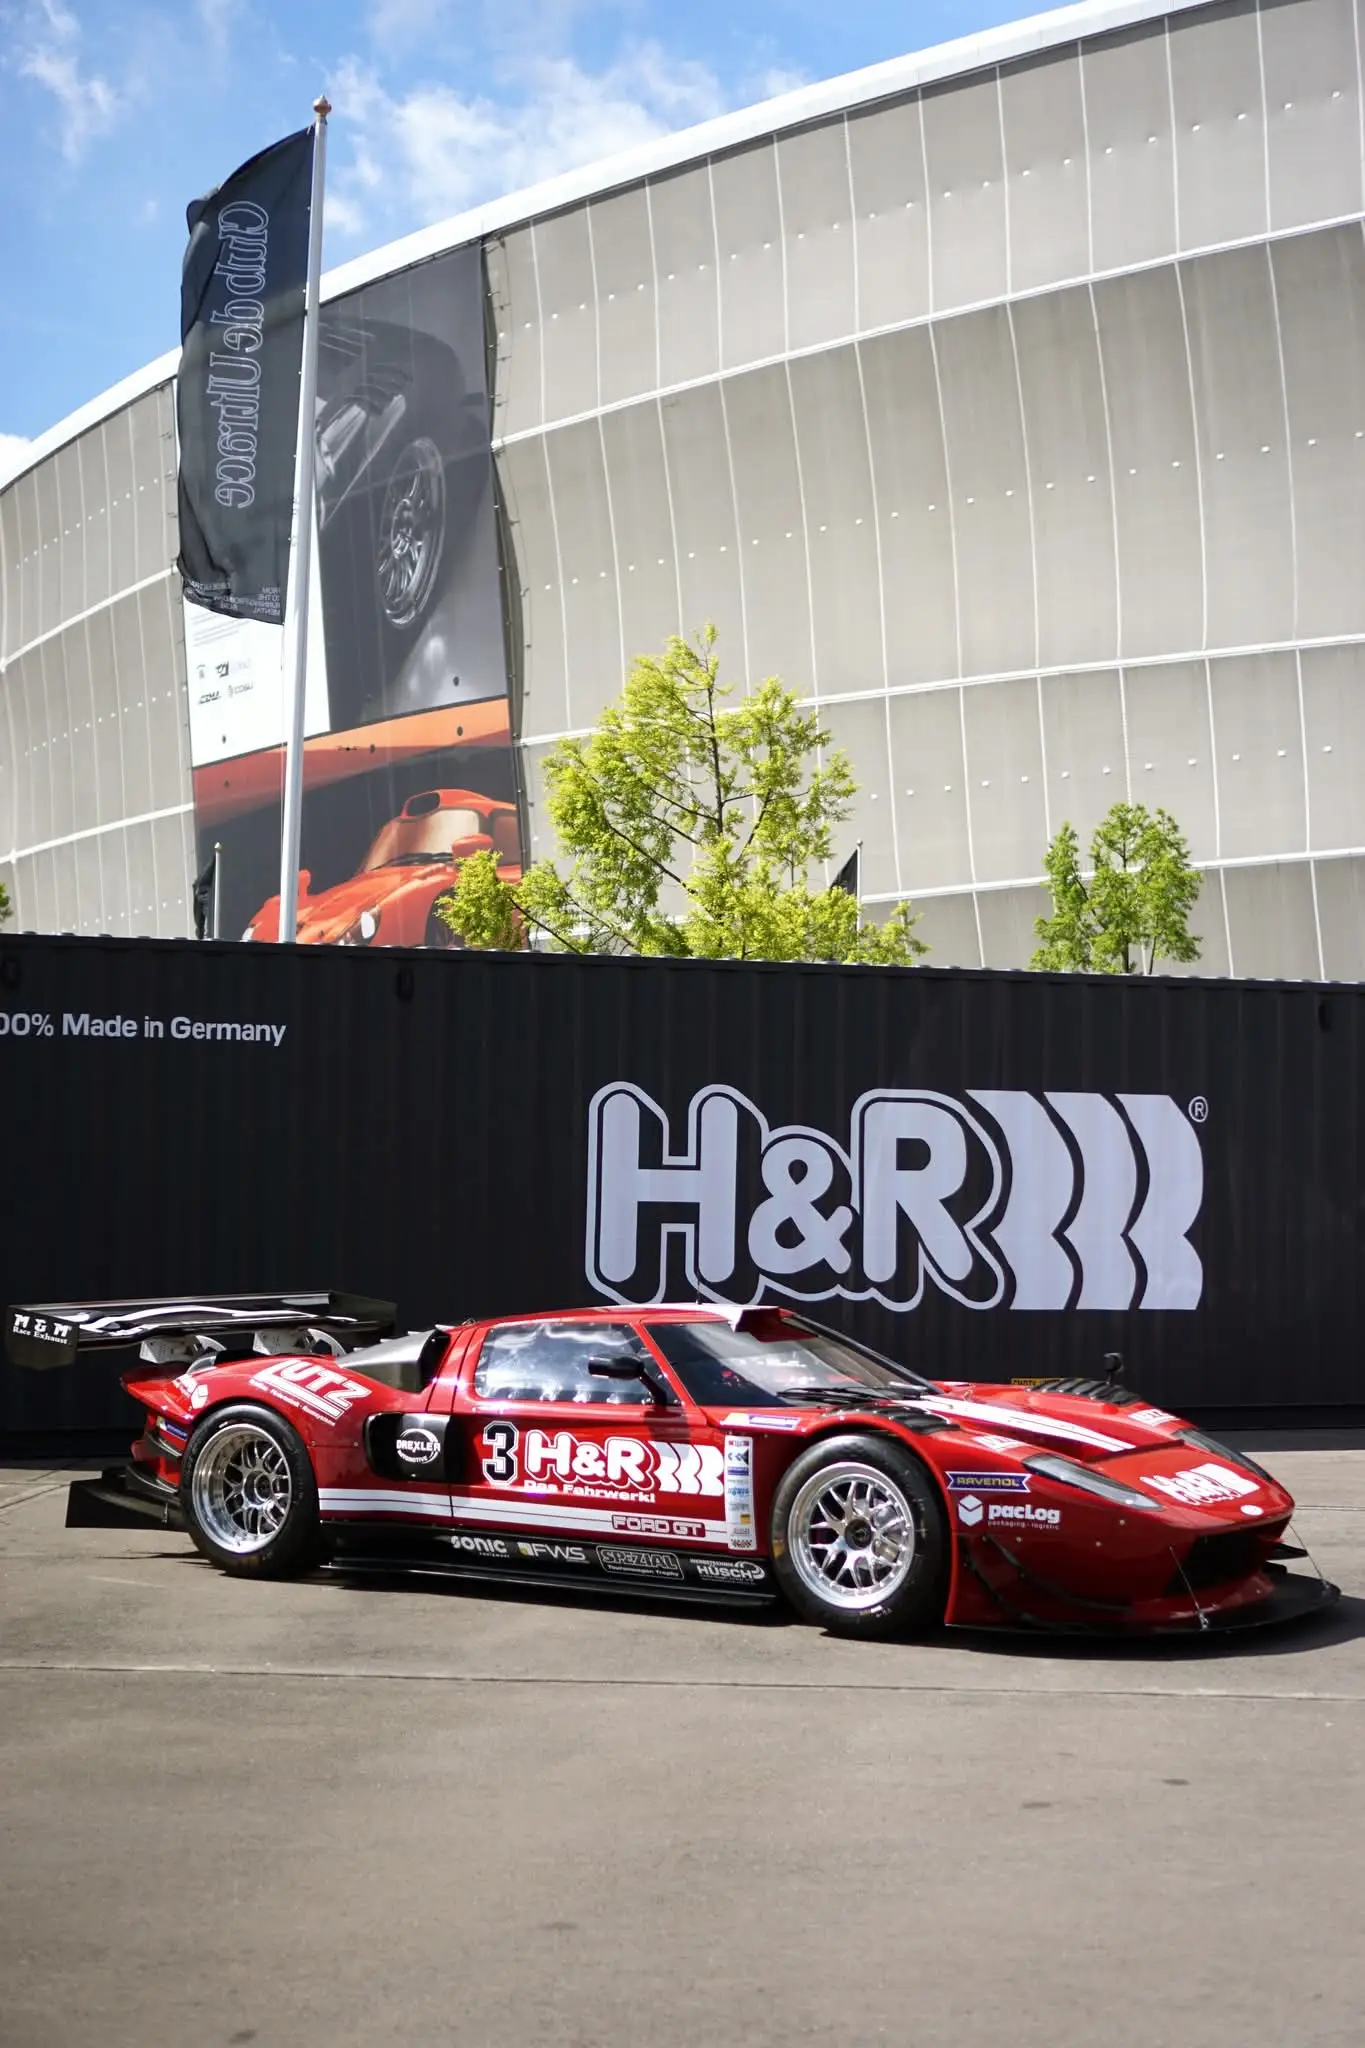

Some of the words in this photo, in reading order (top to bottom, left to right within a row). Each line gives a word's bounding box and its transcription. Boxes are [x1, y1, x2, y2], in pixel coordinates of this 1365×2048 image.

[62, 1013, 137, 1038] Made
[144, 1015, 164, 1038] in
[170, 1016, 286, 1047] Germany
[586, 1081, 1003, 1312] H&R
[12, 1325, 31, 1336] Race
[33, 1330, 68, 1345] Exhaust
[251, 1358, 373, 1421] LUTZ
[396, 1439, 441, 1453] DREXLER
[482, 1420, 520, 1486] 3
[524, 1429, 655, 1491] H&R
[523, 1479, 558, 1493] Das
[957, 1476, 1020, 1487] RAVENOL
[613, 1515, 671, 1534] FORD
[672, 1521, 703, 1536] GT
[601, 1549, 678, 1569] SPEZIAL
